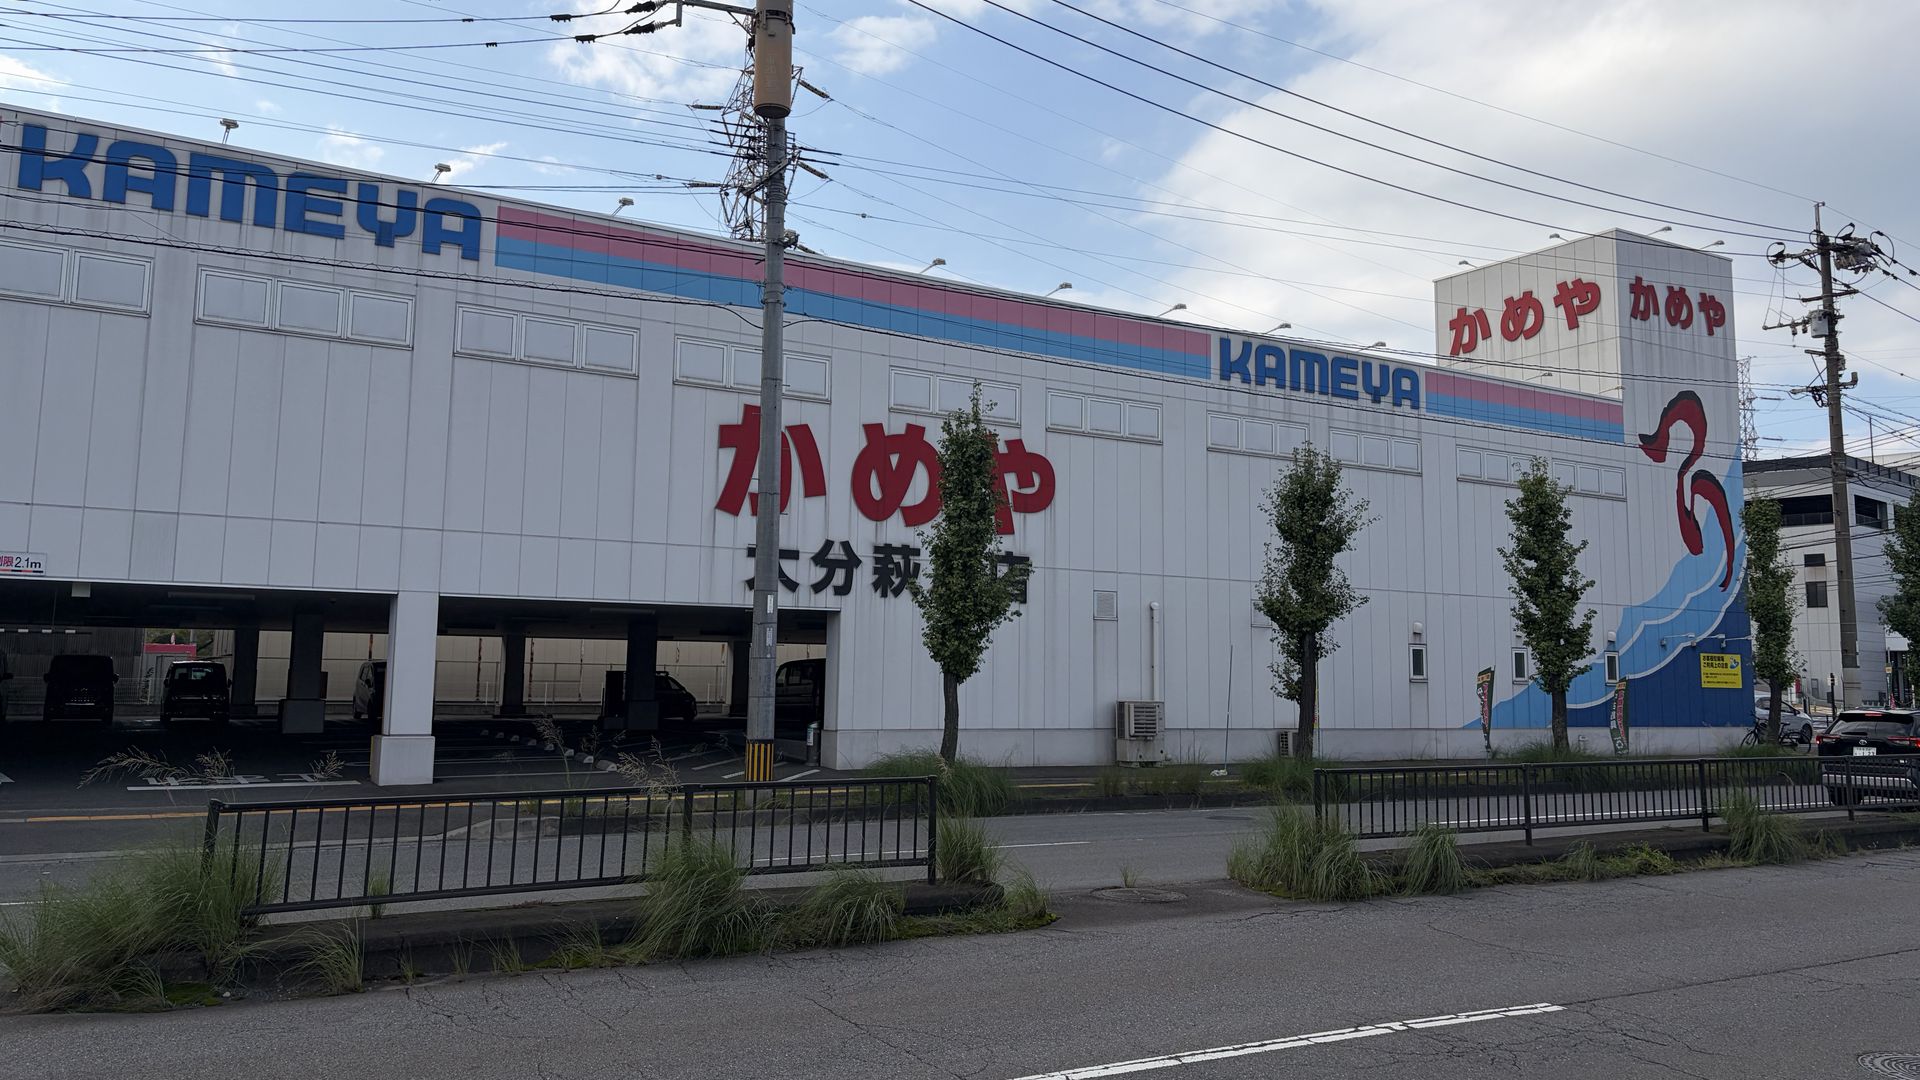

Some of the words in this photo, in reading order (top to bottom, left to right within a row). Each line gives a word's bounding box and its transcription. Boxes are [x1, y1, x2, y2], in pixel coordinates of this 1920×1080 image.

[17, 124, 482, 261] KAMEYA
[1449, 278, 1601, 356] かめや
[1629, 276, 1726, 337] かめや
[1219, 337, 1419, 410] KAMEYA
[716, 404, 1056, 535] かめや
[745, 538, 1031, 604] 大分萩
